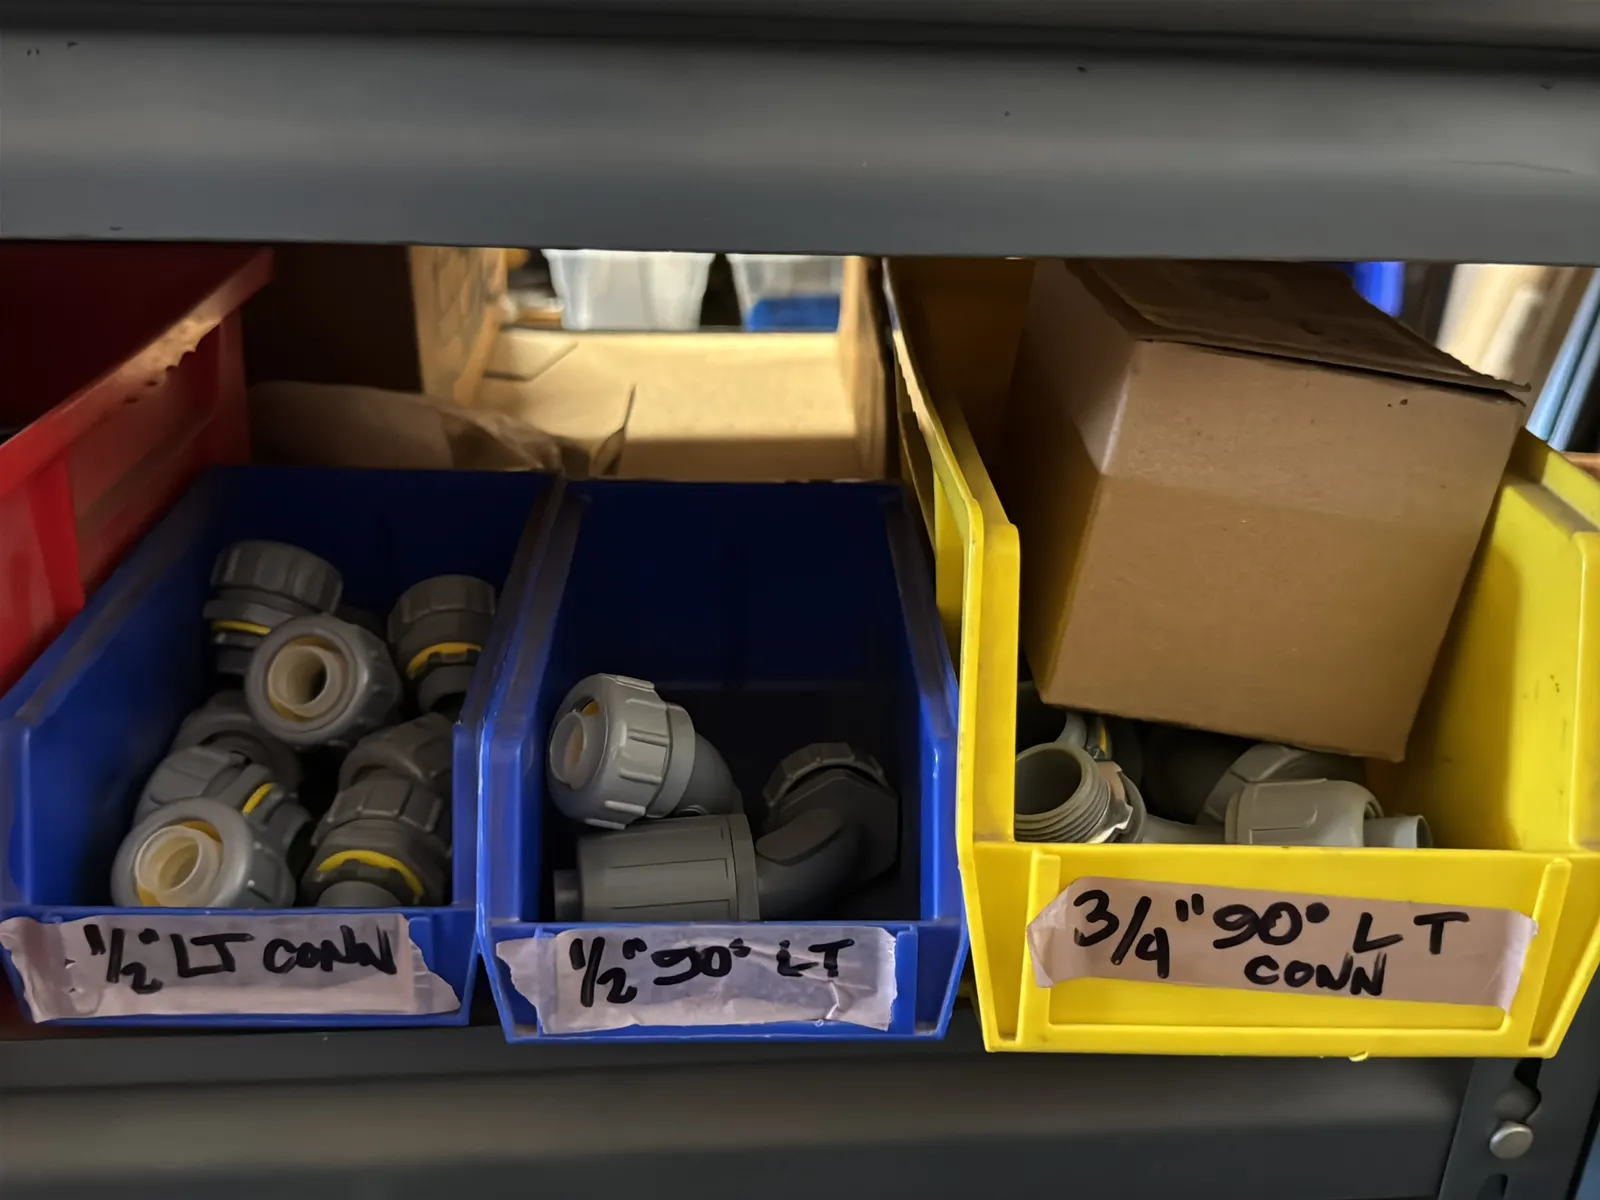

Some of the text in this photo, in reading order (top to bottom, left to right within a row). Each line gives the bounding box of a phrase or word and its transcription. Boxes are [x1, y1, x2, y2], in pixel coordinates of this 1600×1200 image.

[170, 932, 255, 978] LT
[776, 939, 855, 978] LT
[1244, 951, 1388, 998] CONN
